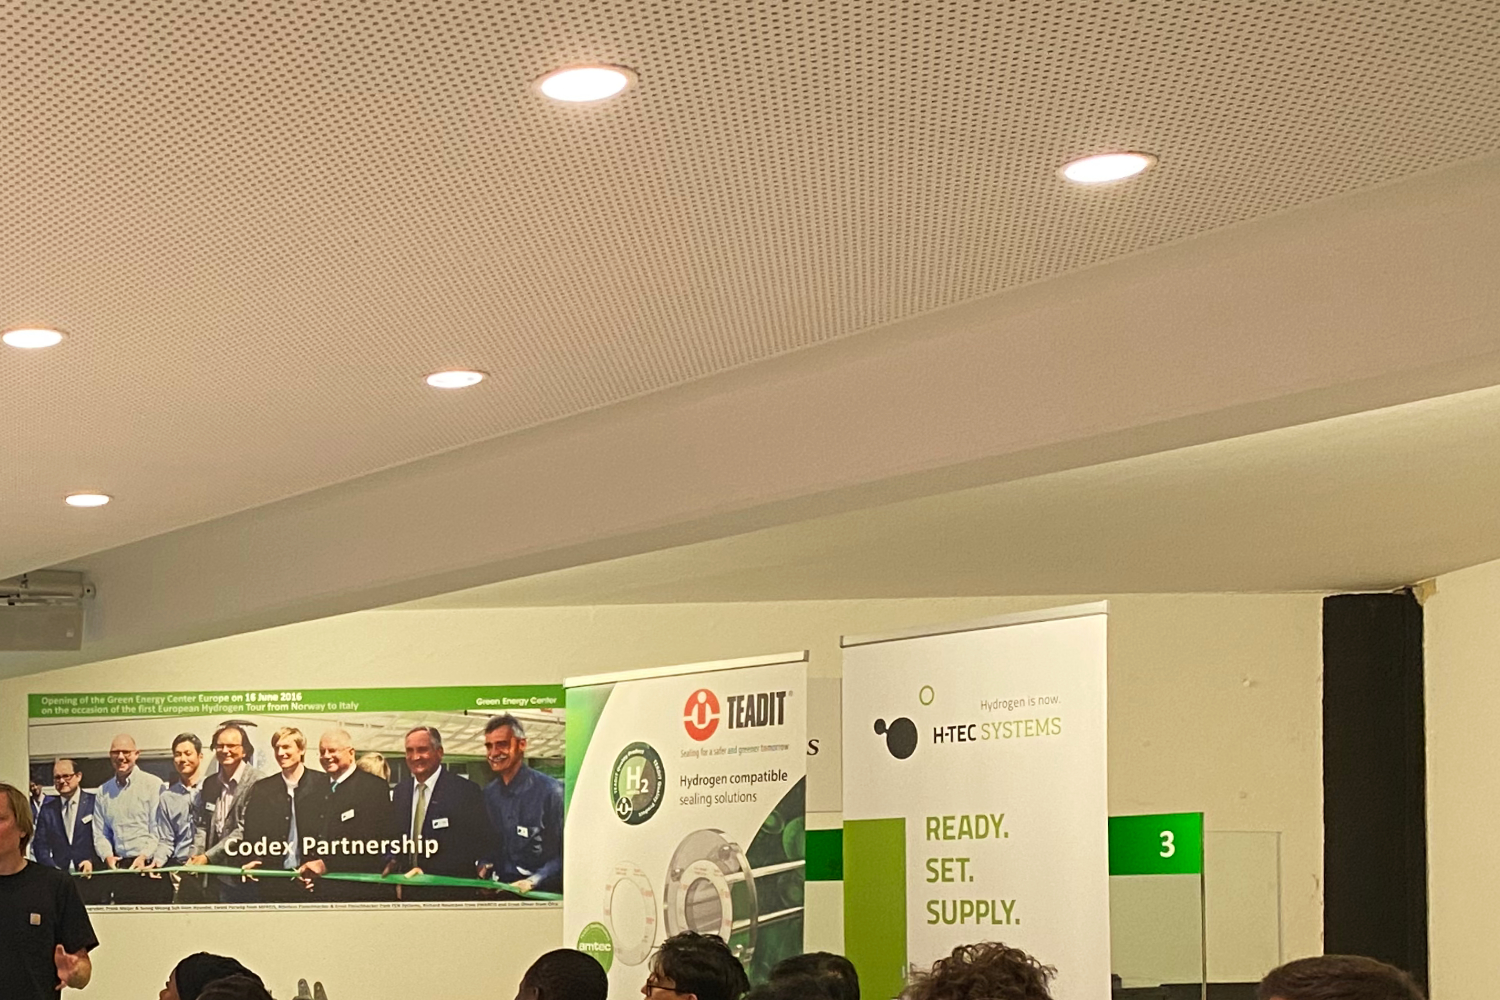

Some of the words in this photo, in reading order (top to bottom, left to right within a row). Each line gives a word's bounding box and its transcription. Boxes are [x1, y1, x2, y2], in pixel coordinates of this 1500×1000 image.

[41, 696, 78, 706] Opening
[79, 695, 88, 704] of
[90, 696, 105, 704] the
[107, 695, 134, 704] Green
[135, 695, 165, 706] Energy
[167, 694, 196, 703] Center
[198, 694, 229, 704] Europe
[231, 694, 243, 702] on
[257, 692, 279, 702] June
[280, 692, 302, 702] 2016
[41, 707, 53, 715] on
[55, 705, 69, 714] the
[71, 705, 108, 714] occasion
[110, 705, 120, 713] of
[122, 704, 136, 713] the
[138, 704, 156, 713] first
[158, 703, 200, 714] European
[201, 703, 244, 714] Hydrogen
[246, 703, 265, 712] Tour
[267, 702, 289, 711] from
[291, 702, 325, 712] Norway
[327, 702, 337, 710] to
[339, 701, 359, 711] Italy
[476, 697, 500, 706] Green
[502, 697, 529, 706] Energy
[530, 696, 557, 704] Center
[980, 698, 1025, 712] Hydrogen
[1028, 696, 1036, 706] is
[1038, 695, 1061, 705] now.
[727, 691, 786, 729] TEADIT
[933, 723, 977, 744] H-TEC
[981, 717, 1062, 740] SYSTEMS
[680, 774, 727, 788] Hydrogen
[729, 769, 788, 786] compatible
[679, 792, 712, 807] sealing
[714, 790, 757, 804] solutions
[926, 813, 1008, 841] READY.
[224, 836, 295, 857] Codex
[302, 834, 439, 858] Partnership
[1159, 830, 1175, 858] 3
[925, 857, 974, 883] SET.
[926, 899, 1020, 925] SUPPLY.
[579, 942, 612, 952] amtec
